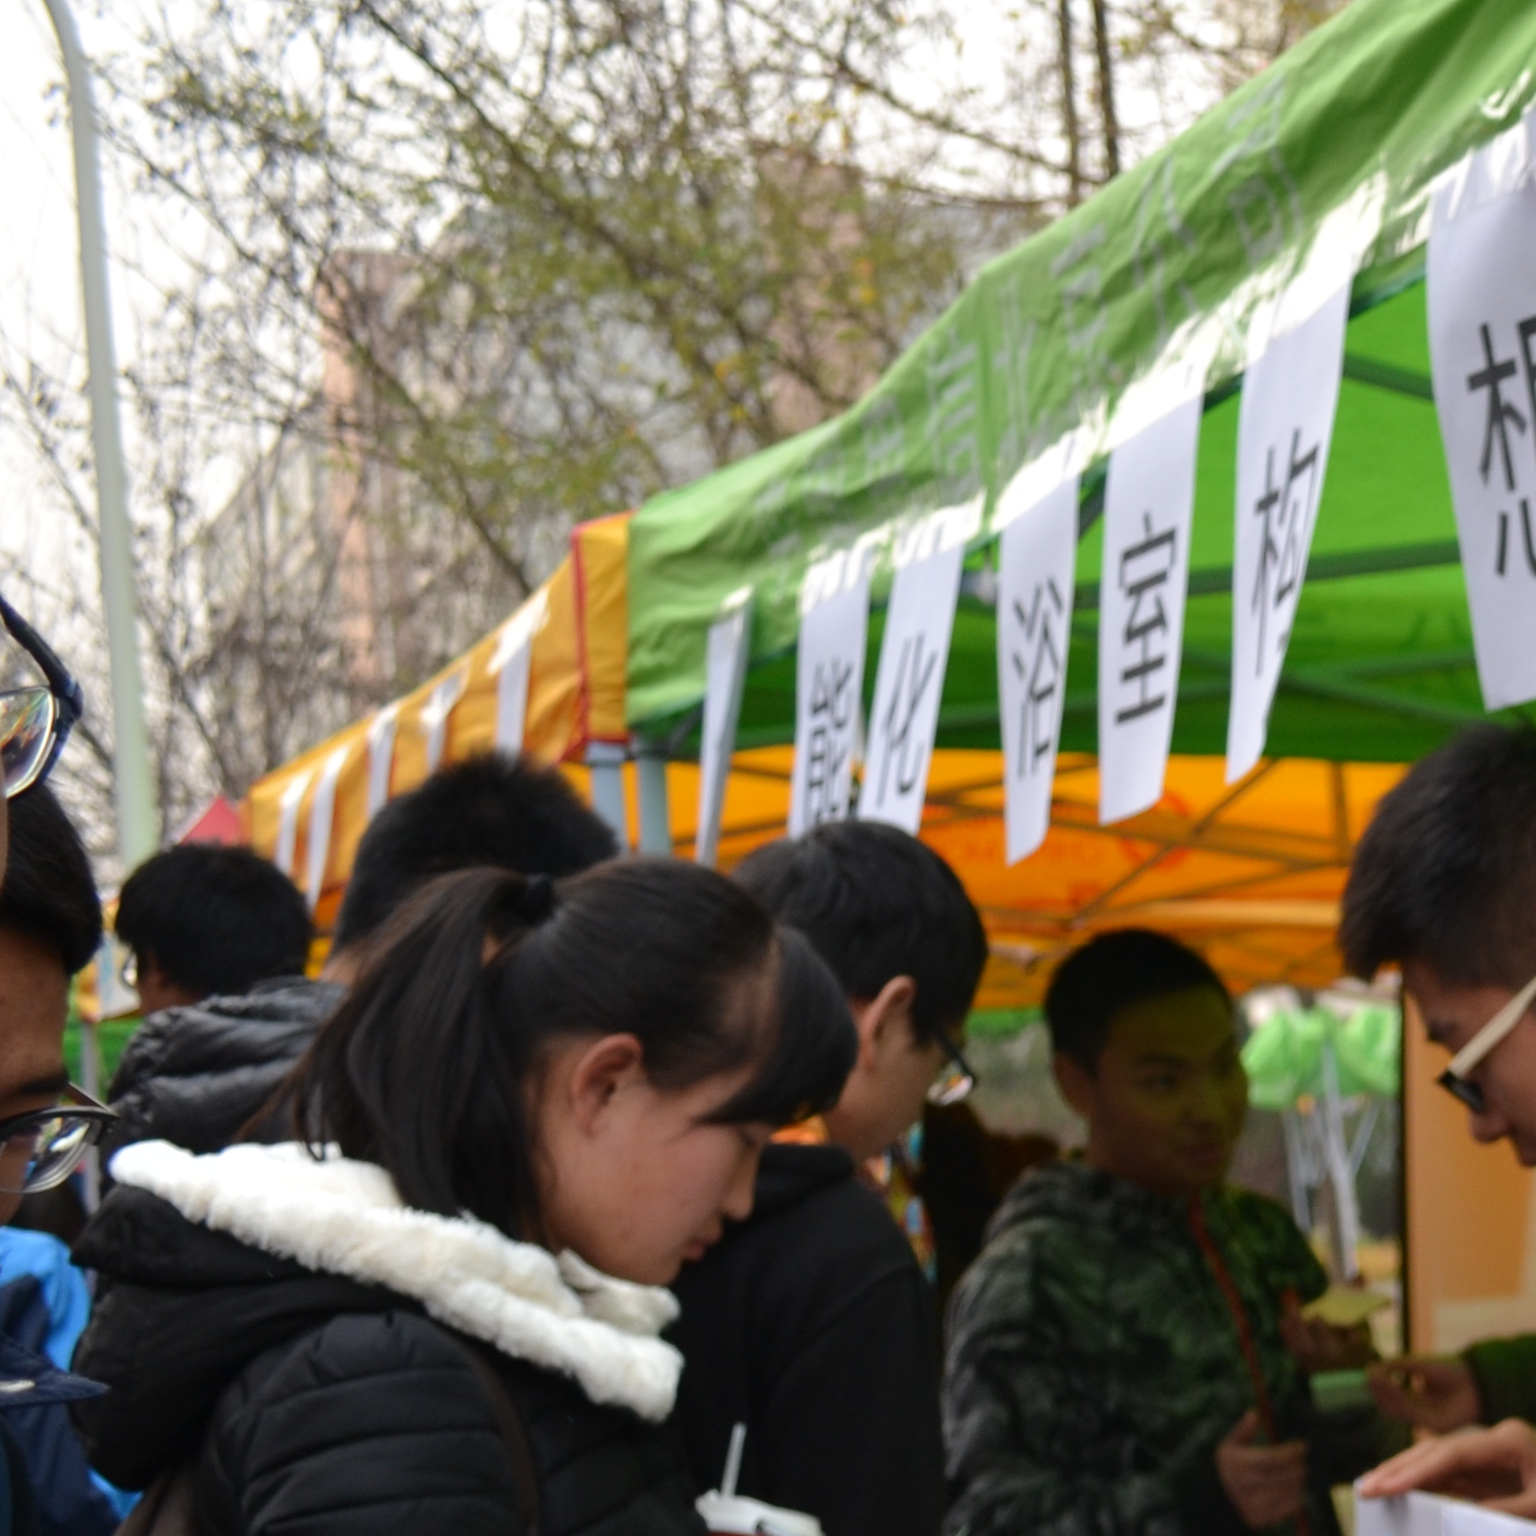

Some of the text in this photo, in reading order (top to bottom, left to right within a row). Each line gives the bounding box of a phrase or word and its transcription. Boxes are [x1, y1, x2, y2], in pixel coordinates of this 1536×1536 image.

[1011, 577, 1066, 780] 浴
[1116, 510, 1177, 726] 室
[876, 630, 939, 810] 化
